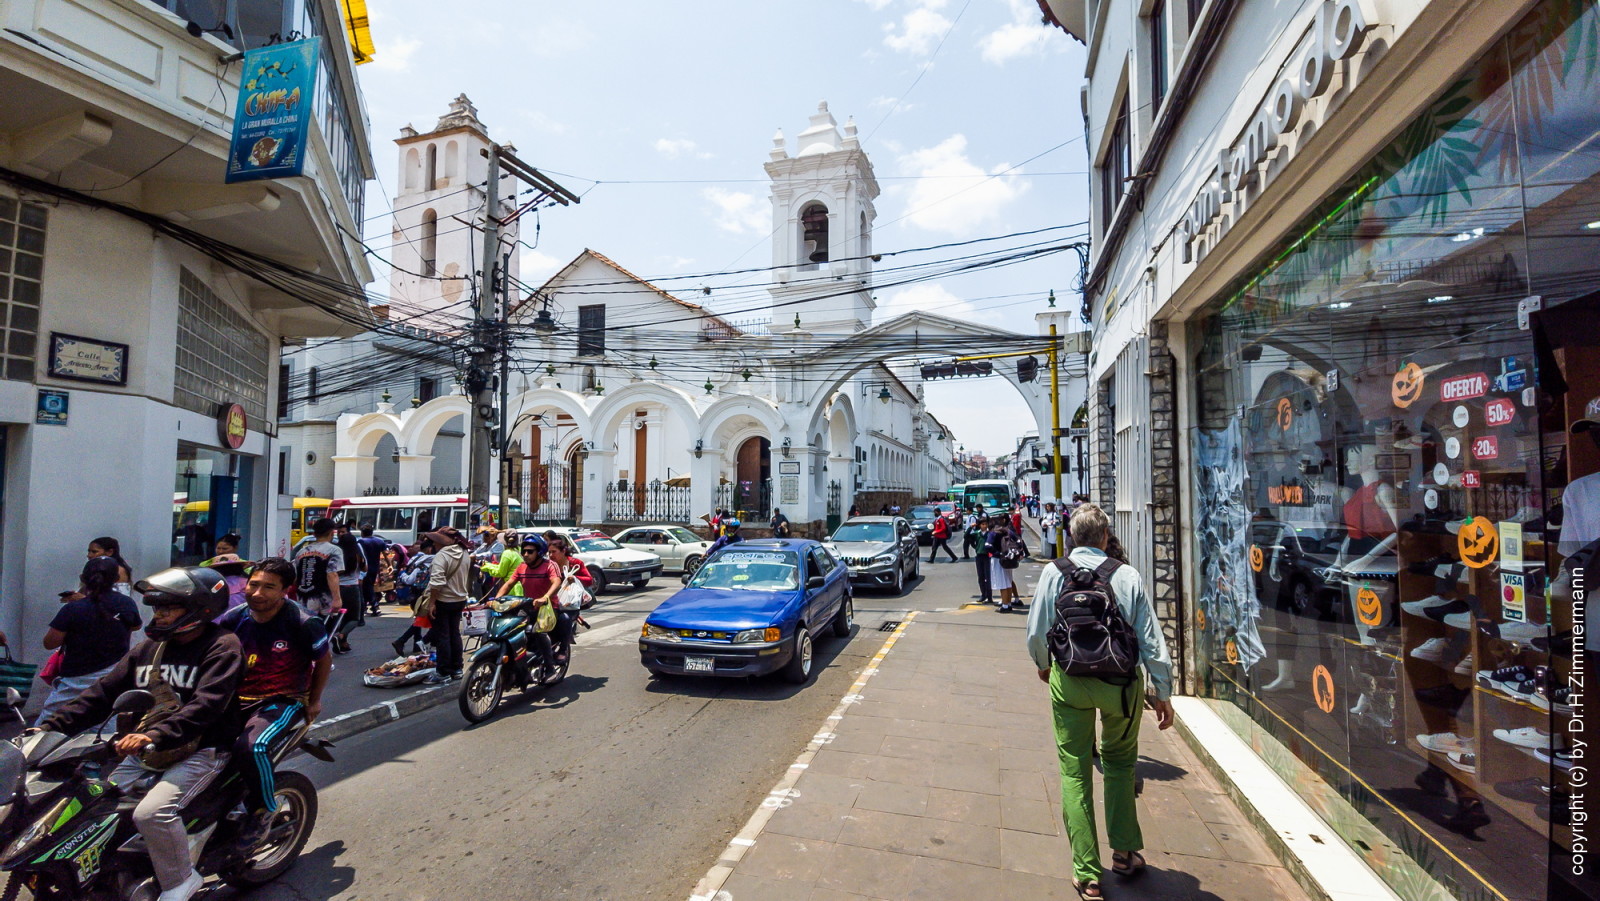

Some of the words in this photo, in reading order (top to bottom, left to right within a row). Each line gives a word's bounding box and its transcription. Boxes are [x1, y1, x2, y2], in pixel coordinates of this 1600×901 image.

[245, 87, 300, 116] CHIFA
[242, 121, 248, 130] LA
[248, 120, 260, 128] GRAN
[261, 117, 282, 126] MURALLA
[282, 114, 298, 124] CHINA
[78, 351, 100, 360] Calle
[1443, 376, 1483, 399] OFERTA
[1488, 403, 1510, 423] 50%
[1477, 440, 1496, 456] 20%
[1466, 473, 1478, 484] 10%
[1503, 575, 1523, 586] VISA
[56, 822, 101, 856] MONSTER
